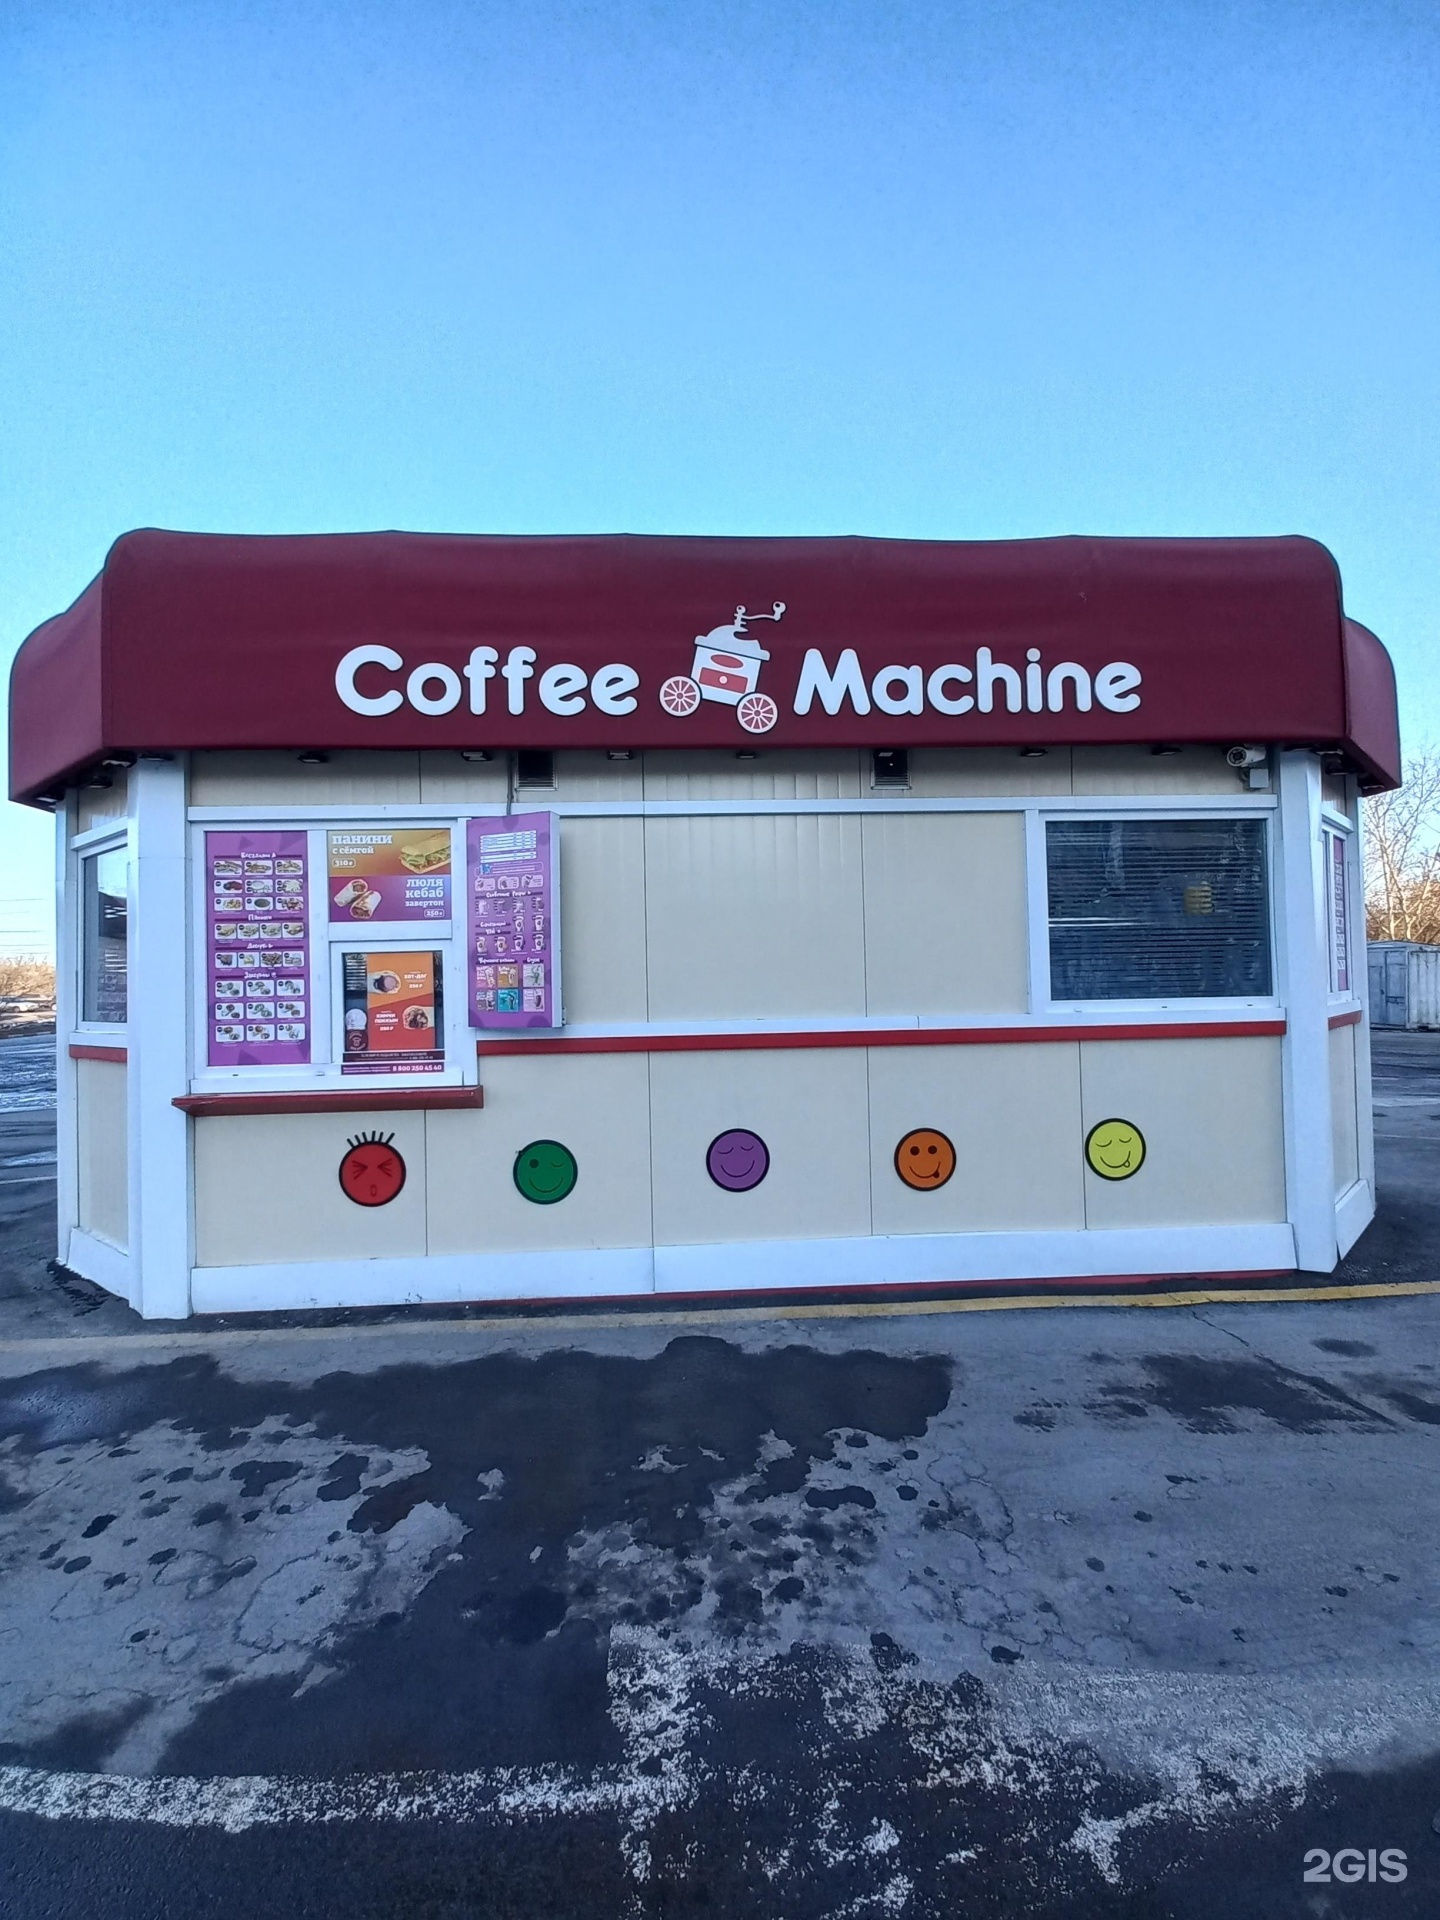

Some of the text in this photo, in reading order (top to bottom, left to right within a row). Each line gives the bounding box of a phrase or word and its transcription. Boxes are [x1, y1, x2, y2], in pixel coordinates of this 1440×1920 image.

[334, 644, 1142, 717] Coffee Machine
[332, 834, 393, 845] панини
[406, 878, 444, 887] люля
[405, 887, 444, 898] кебаб
